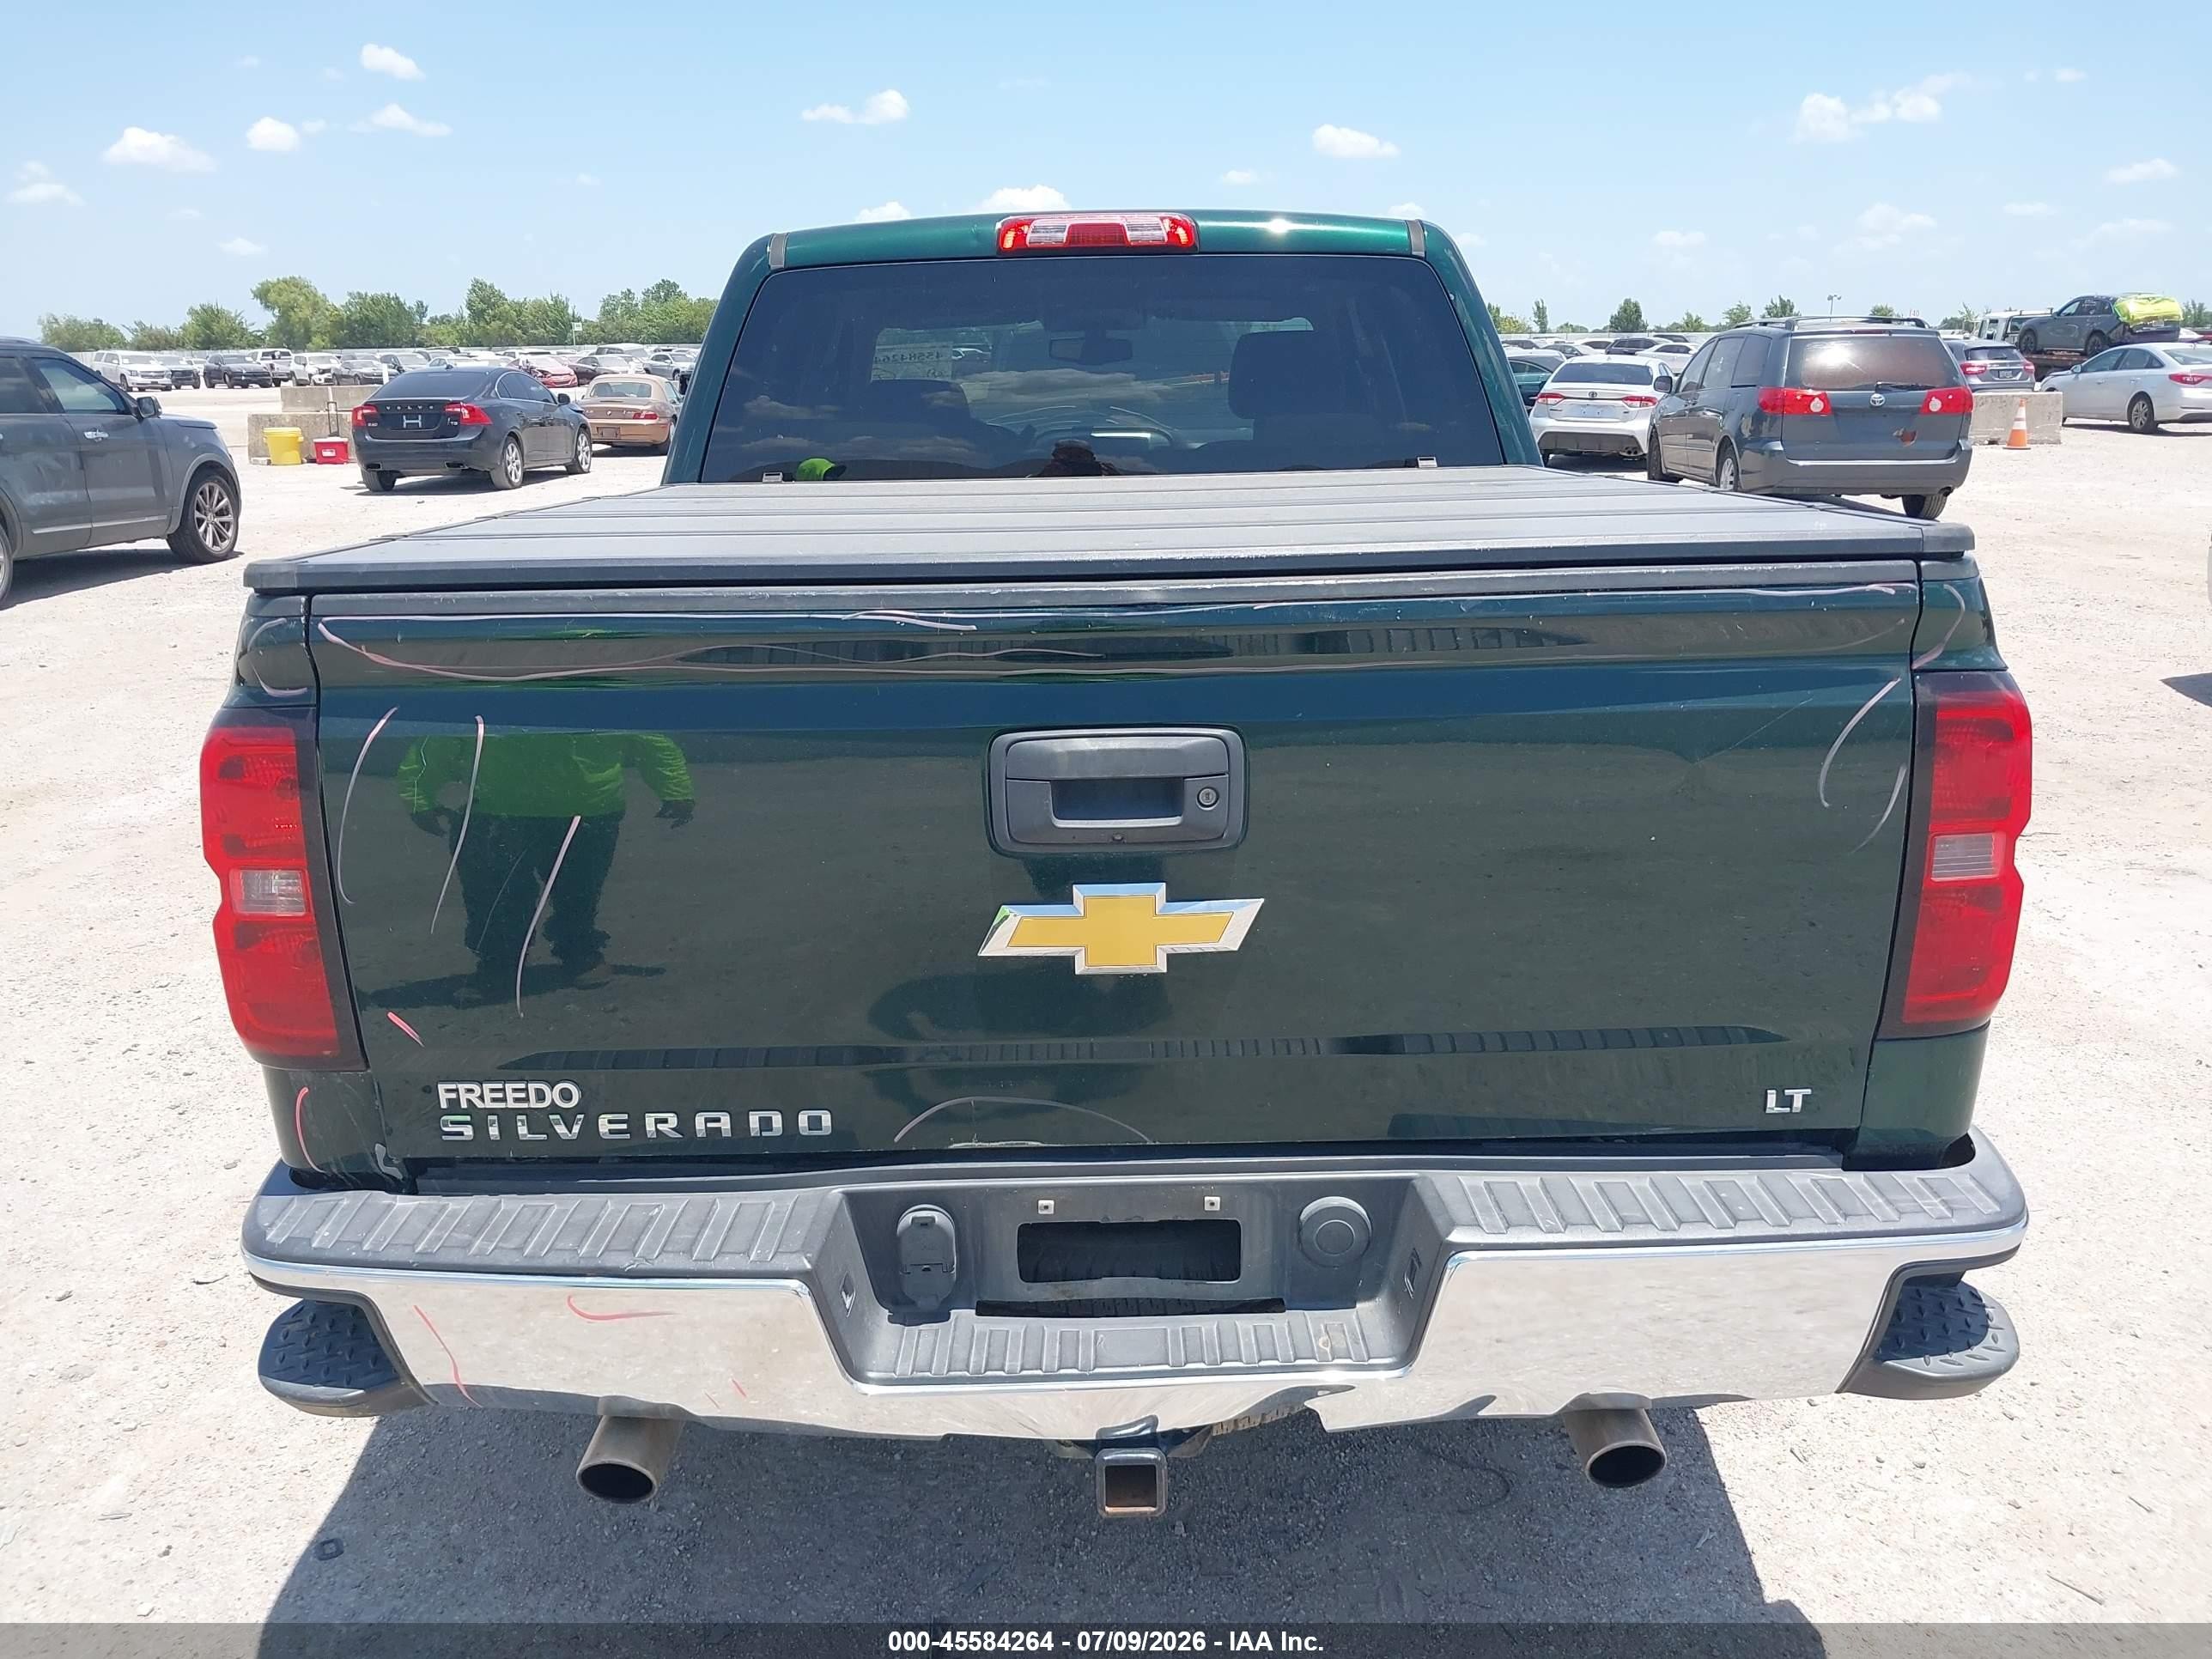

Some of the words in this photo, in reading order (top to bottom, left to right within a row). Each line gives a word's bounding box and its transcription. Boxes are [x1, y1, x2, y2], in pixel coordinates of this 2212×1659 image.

[436, 1080, 582, 1109] FREEDO
[1765, 1088, 1812, 1114] LT
[441, 1109, 833, 1140] SILVERADO
